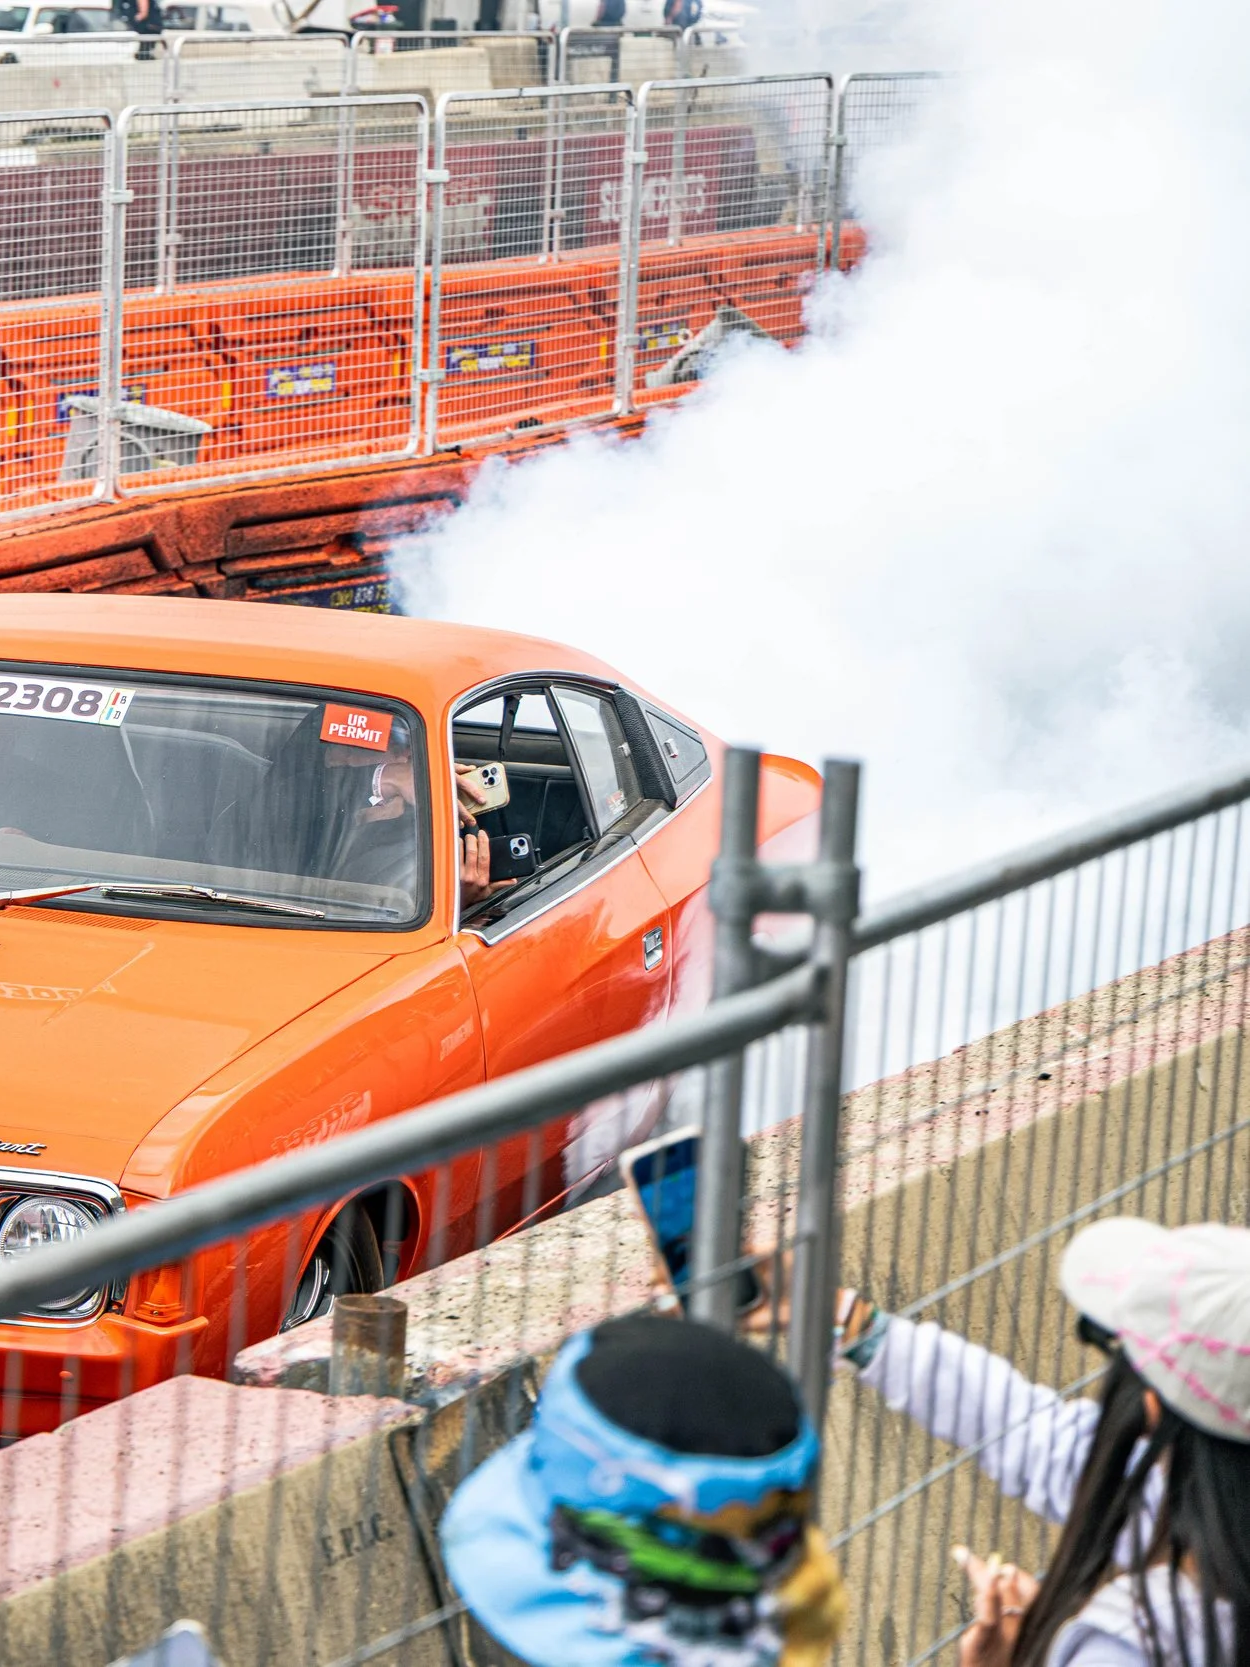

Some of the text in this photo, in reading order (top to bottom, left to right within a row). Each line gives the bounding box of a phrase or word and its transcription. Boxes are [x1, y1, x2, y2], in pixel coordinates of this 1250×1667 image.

[120, 695, 127, 705] B
[113, 711, 121, 720] D
[347, 713, 368, 728] UR
[328, 723, 383, 743] PERMIT
